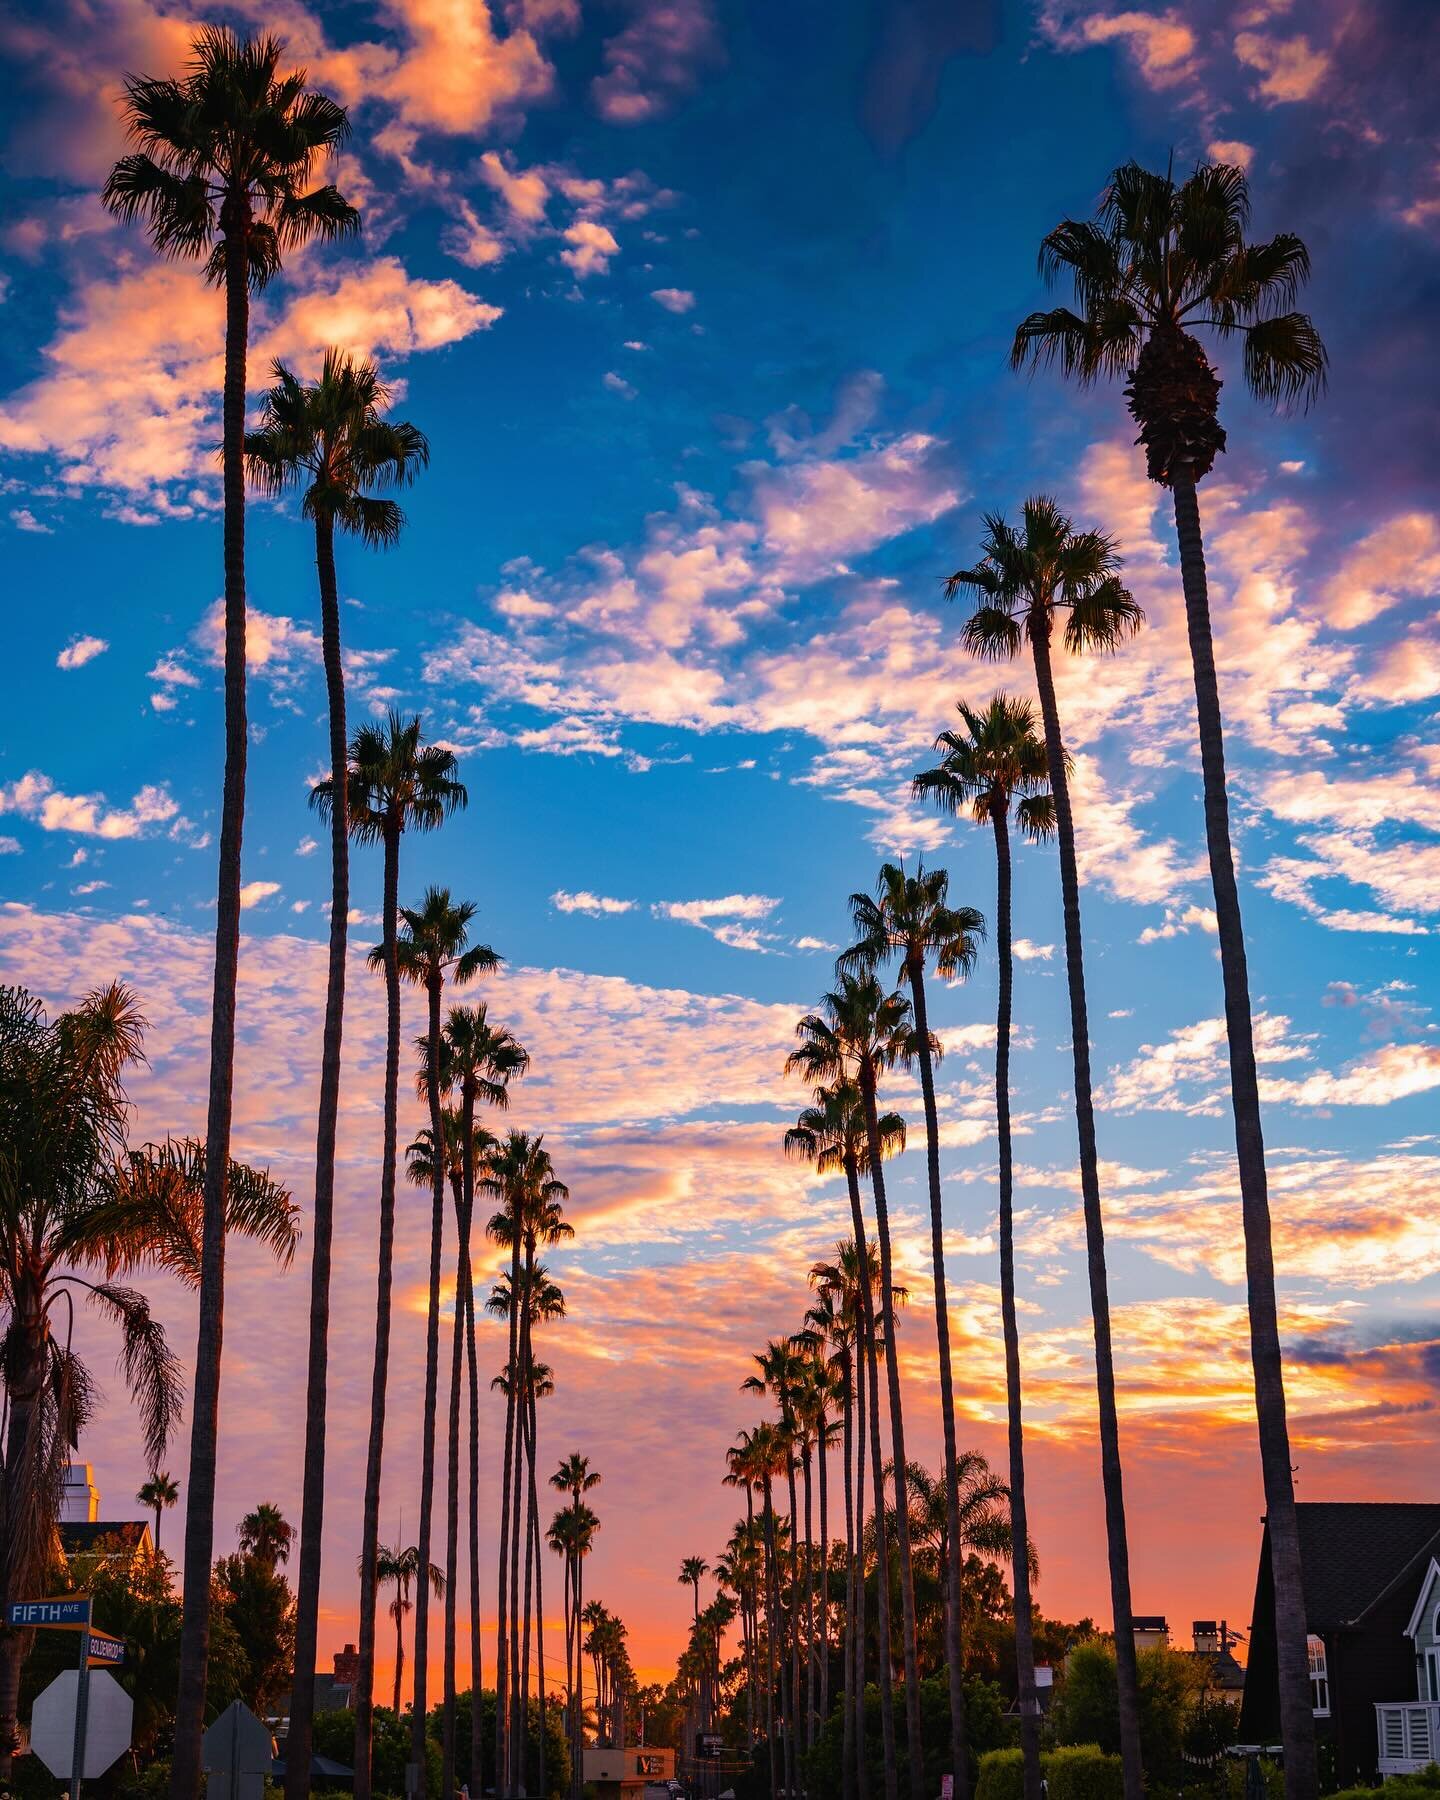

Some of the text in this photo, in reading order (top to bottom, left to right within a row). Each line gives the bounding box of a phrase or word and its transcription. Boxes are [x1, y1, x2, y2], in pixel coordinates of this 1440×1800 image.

[12, 1604, 79, 1621] FIFTH AVE
[90, 1639, 119, 1658] GOLDENROD
